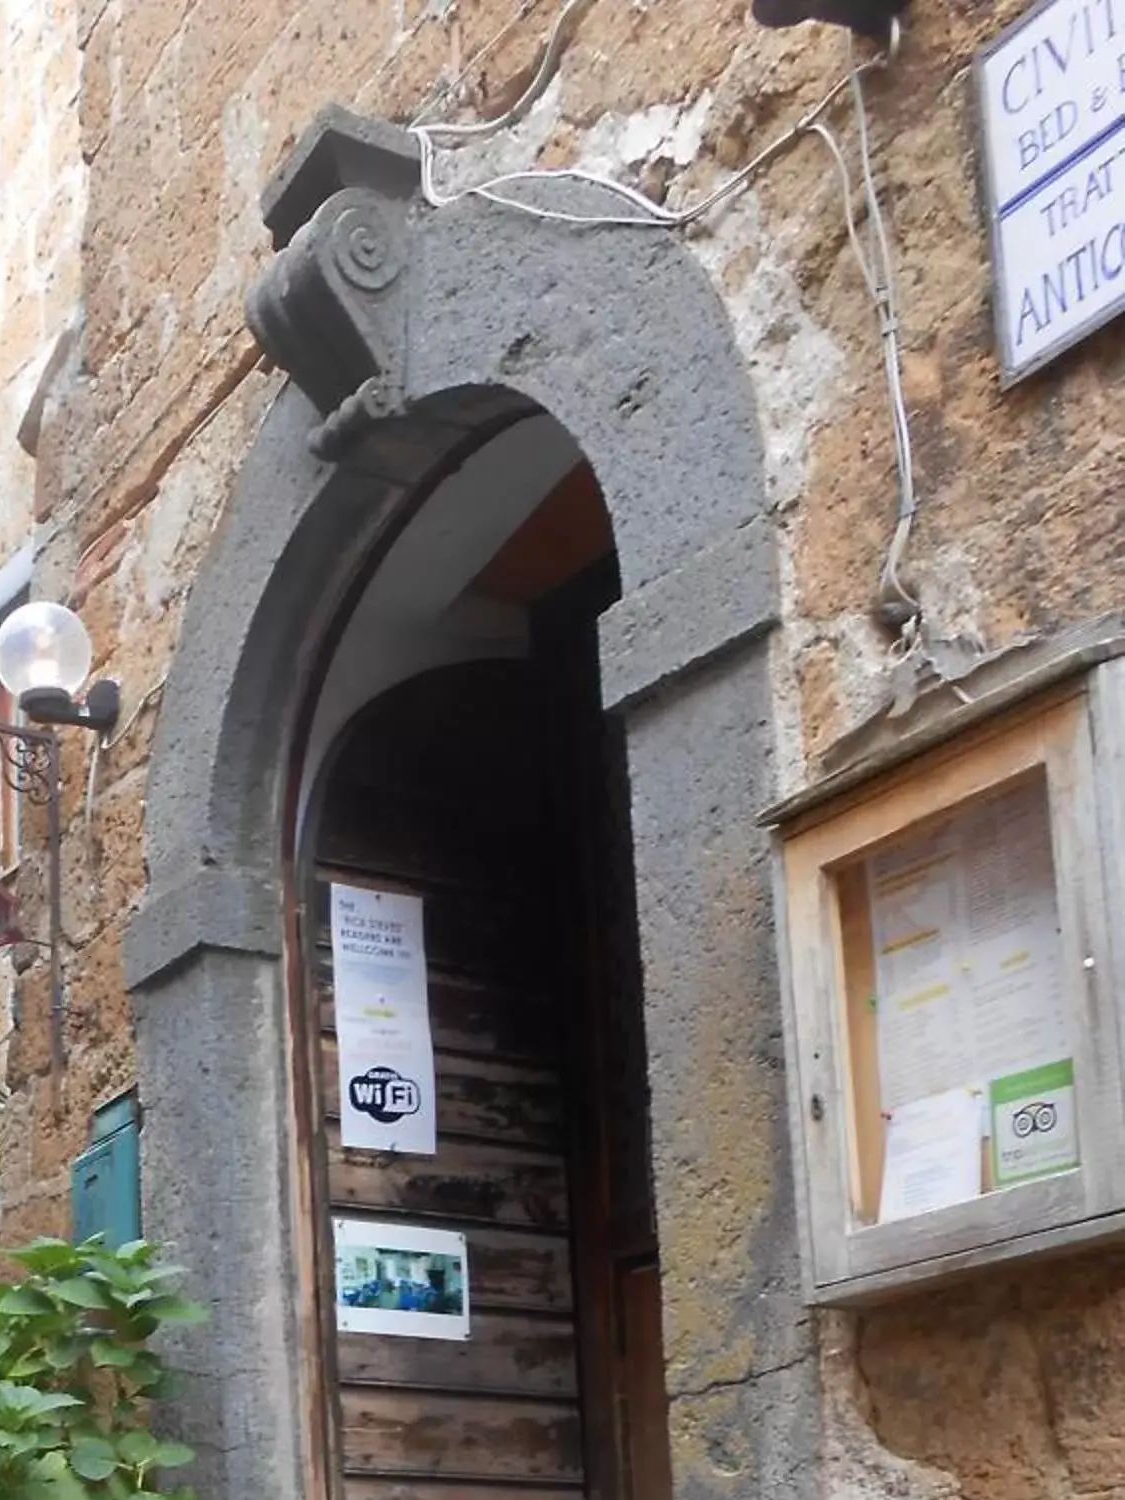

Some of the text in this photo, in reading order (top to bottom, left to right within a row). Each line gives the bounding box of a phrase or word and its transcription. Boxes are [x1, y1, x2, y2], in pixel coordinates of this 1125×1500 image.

[1018, 85, 1109, 172] BED &
[1040, 146, 1125, 237] TRAT
[1016, 222, 1125, 346] ANTIC
